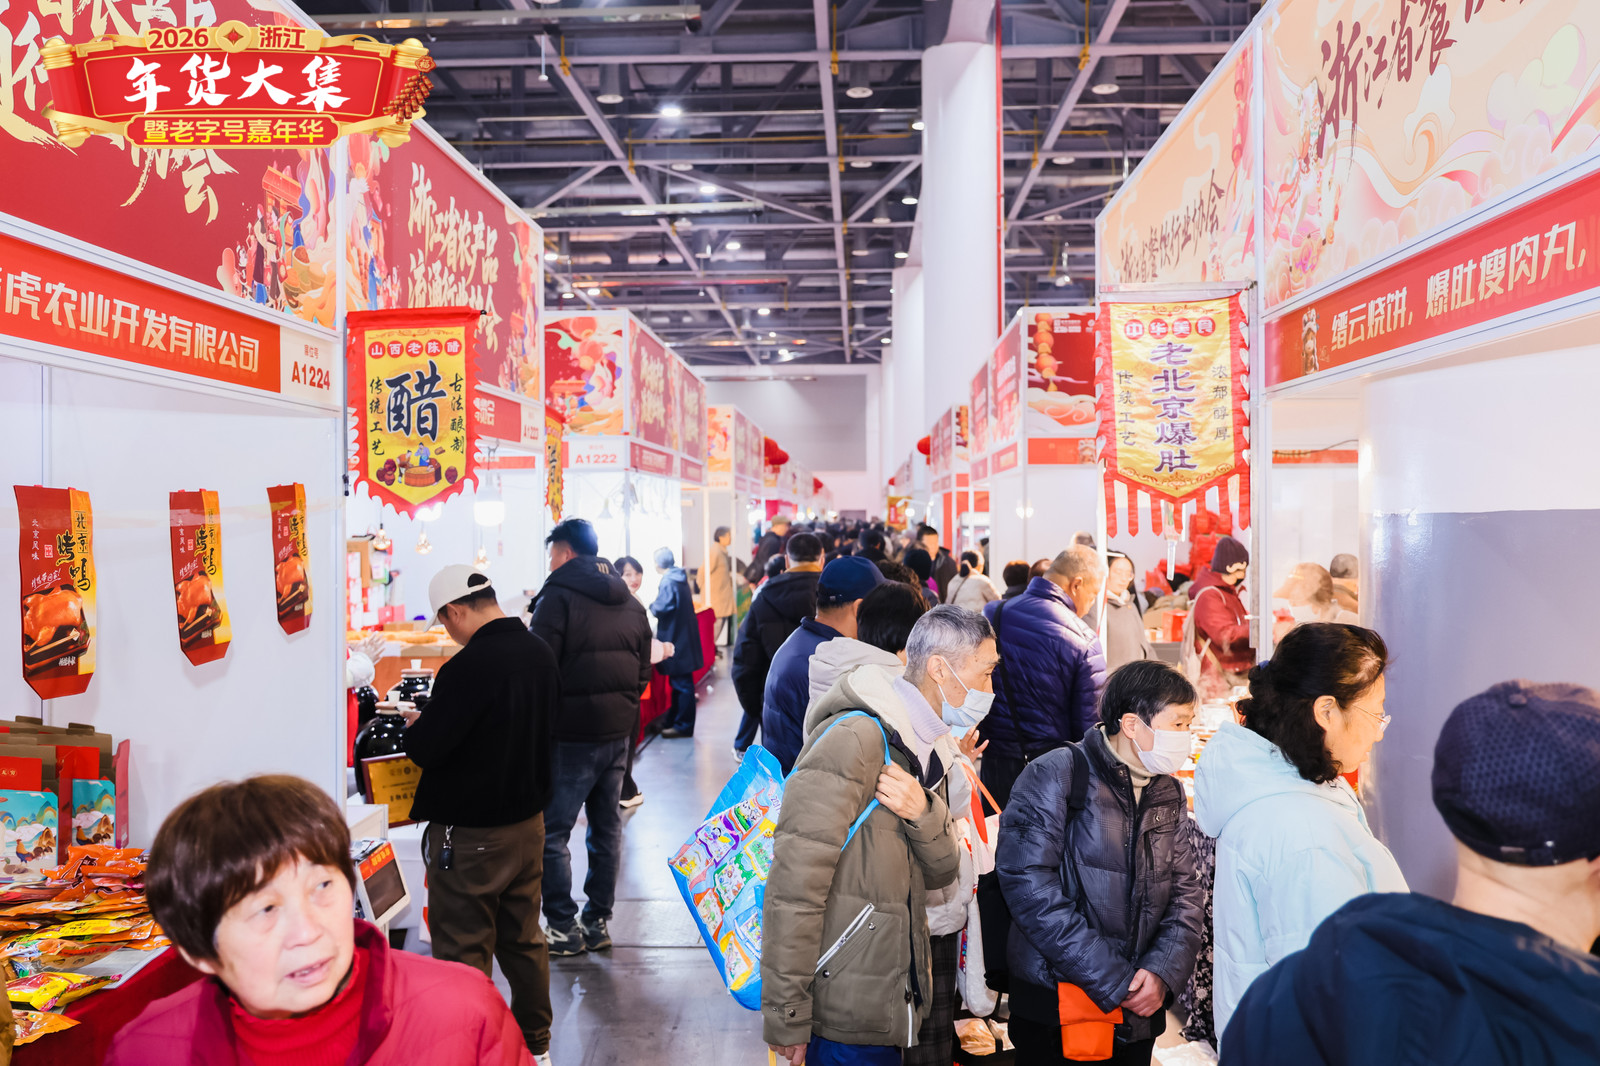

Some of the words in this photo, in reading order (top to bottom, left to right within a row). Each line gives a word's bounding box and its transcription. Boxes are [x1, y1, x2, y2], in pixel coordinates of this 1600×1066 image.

[1316, 0, 1485, 160] 浙江省餐
[408, 161, 500, 286] 浙江省农产品
[0, 267, 260, 373] 虎农业开发有限公司
[370, 340, 461, 357] 山西老陈醋
[1125, 318, 1214, 337] 中华美食
[291, 360, 331, 391] A1224
[384, 359, 447, 442] 醋
[449, 372, 466, 455] 古法酿制
[1116, 369, 1136, 446] 传统工艺
[1149, 341, 1198, 473] 老北京爆肚
[1211, 364, 1231, 441] 浓郁醇厚
[369, 376, 385, 456] 传统工艺
[575, 453, 618, 464] A1222
[56, 530, 91, 592] 烤鸭
[76, 512, 87, 553] 北京
